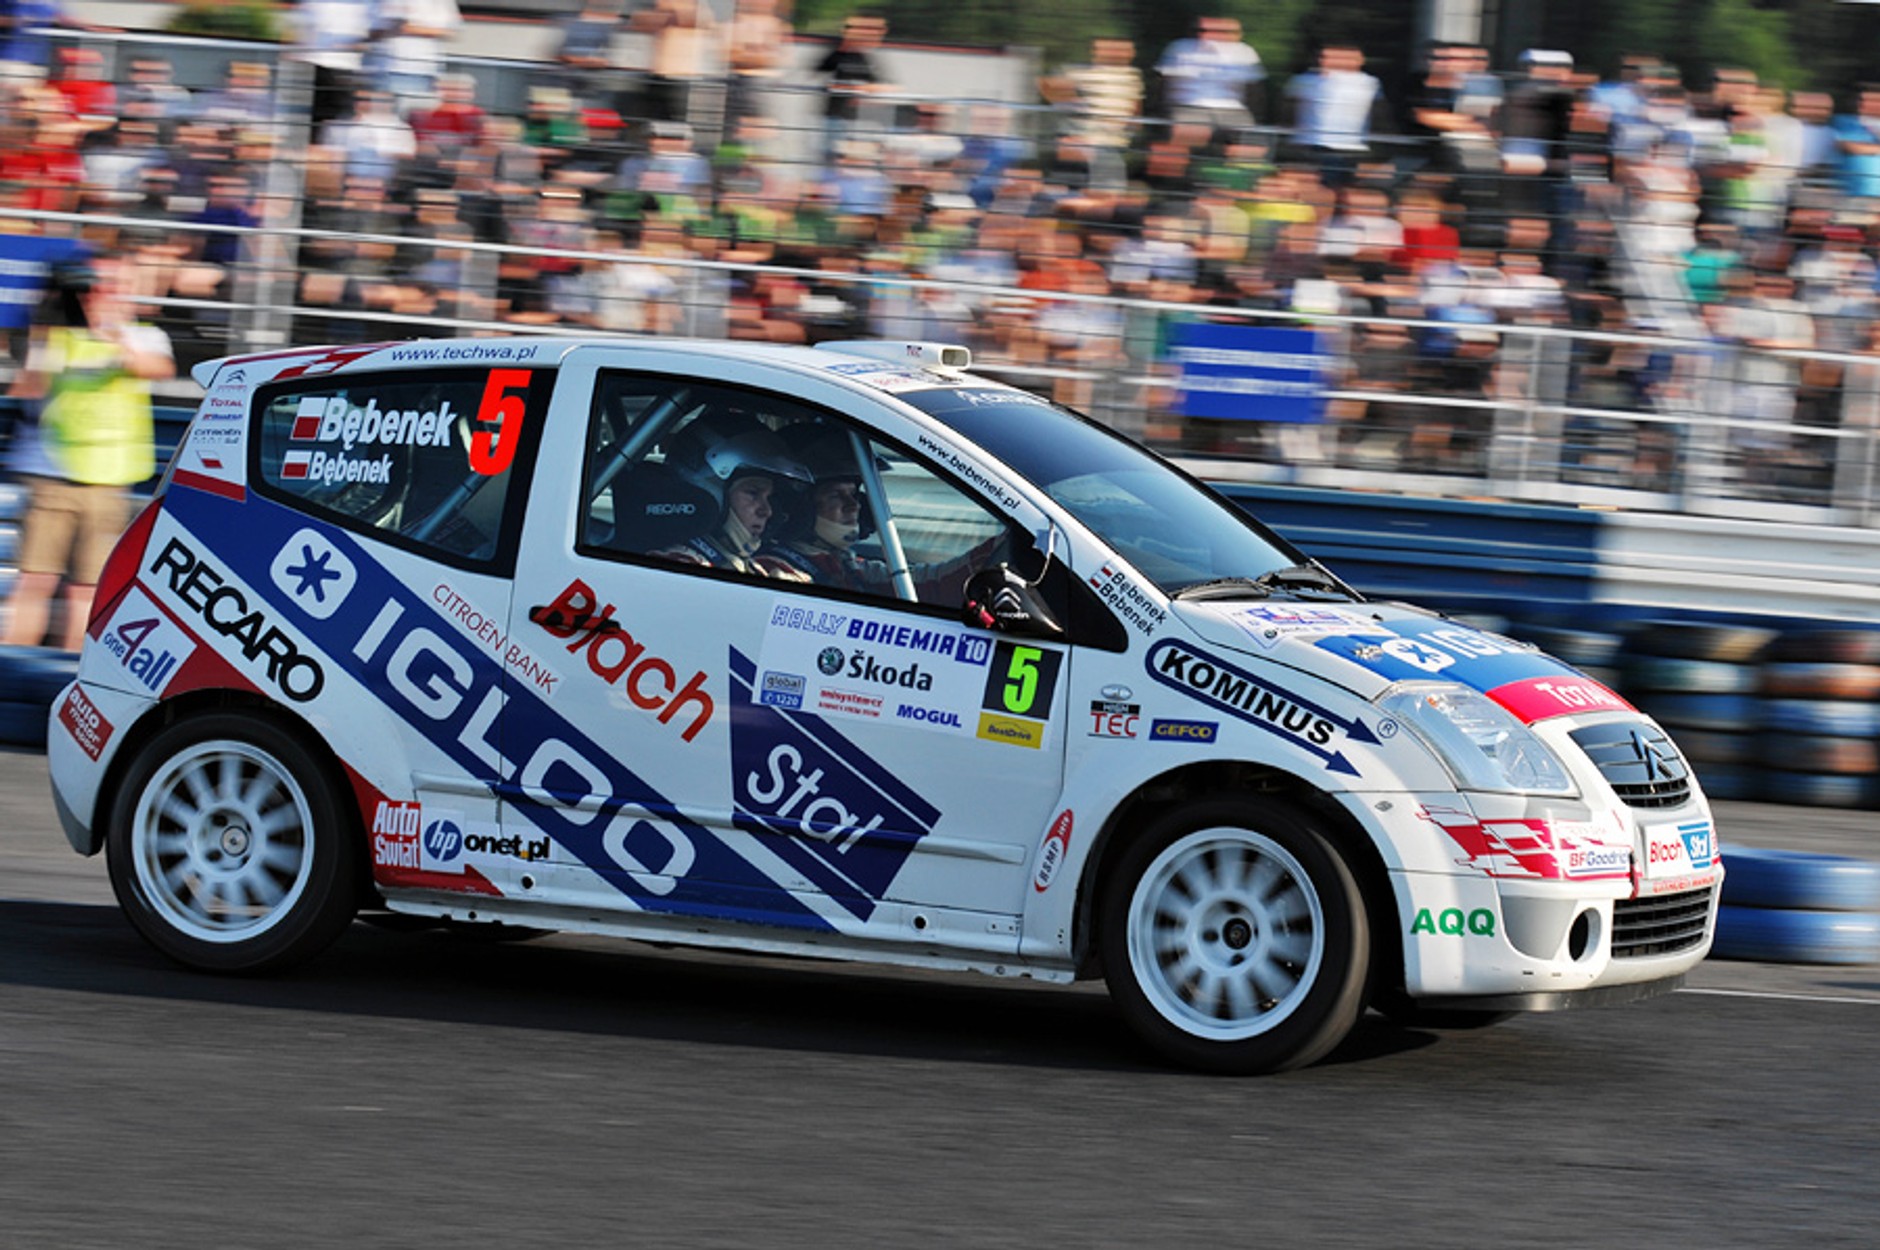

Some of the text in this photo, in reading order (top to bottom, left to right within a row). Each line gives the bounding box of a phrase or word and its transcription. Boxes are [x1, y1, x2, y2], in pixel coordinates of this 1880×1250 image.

[391, 345, 537, 362] www.techwa.pl
[319, 398, 457, 452] Bębenek
[469, 368, 532, 475] 5
[309, 451, 393, 486] Bębenek
[919, 434, 1021, 510] www.bebenek.pl
[150, 536, 324, 702] RECARO
[1099, 582, 1155, 636] Bębenek
[1111, 571, 1167, 625] Bębenek
[104, 631, 126, 658] one
[433, 583, 558, 694] CITROËN BANK
[771, 604, 847, 636] RALLY
[846, 618, 957, 656] BOHEMIA
[767, 675, 801, 689] global
[847, 649, 933, 692] Škoda
[1003, 646, 1043, 714] 5
[896, 704, 962, 728] MOGUL
[1161, 648, 1335, 746] KOMINUS
[352, 597, 696, 896] IGLOO
[1090, 711, 1140, 738] TEC
[1156, 723, 1213, 739] GEFCO
[372, 801, 420, 836] Auto
[747, 744, 885, 856] Stal
[428, 819, 458, 862] hp
[464, 834, 551, 862] onet.pl
[1410, 907, 1496, 938] AQQ
